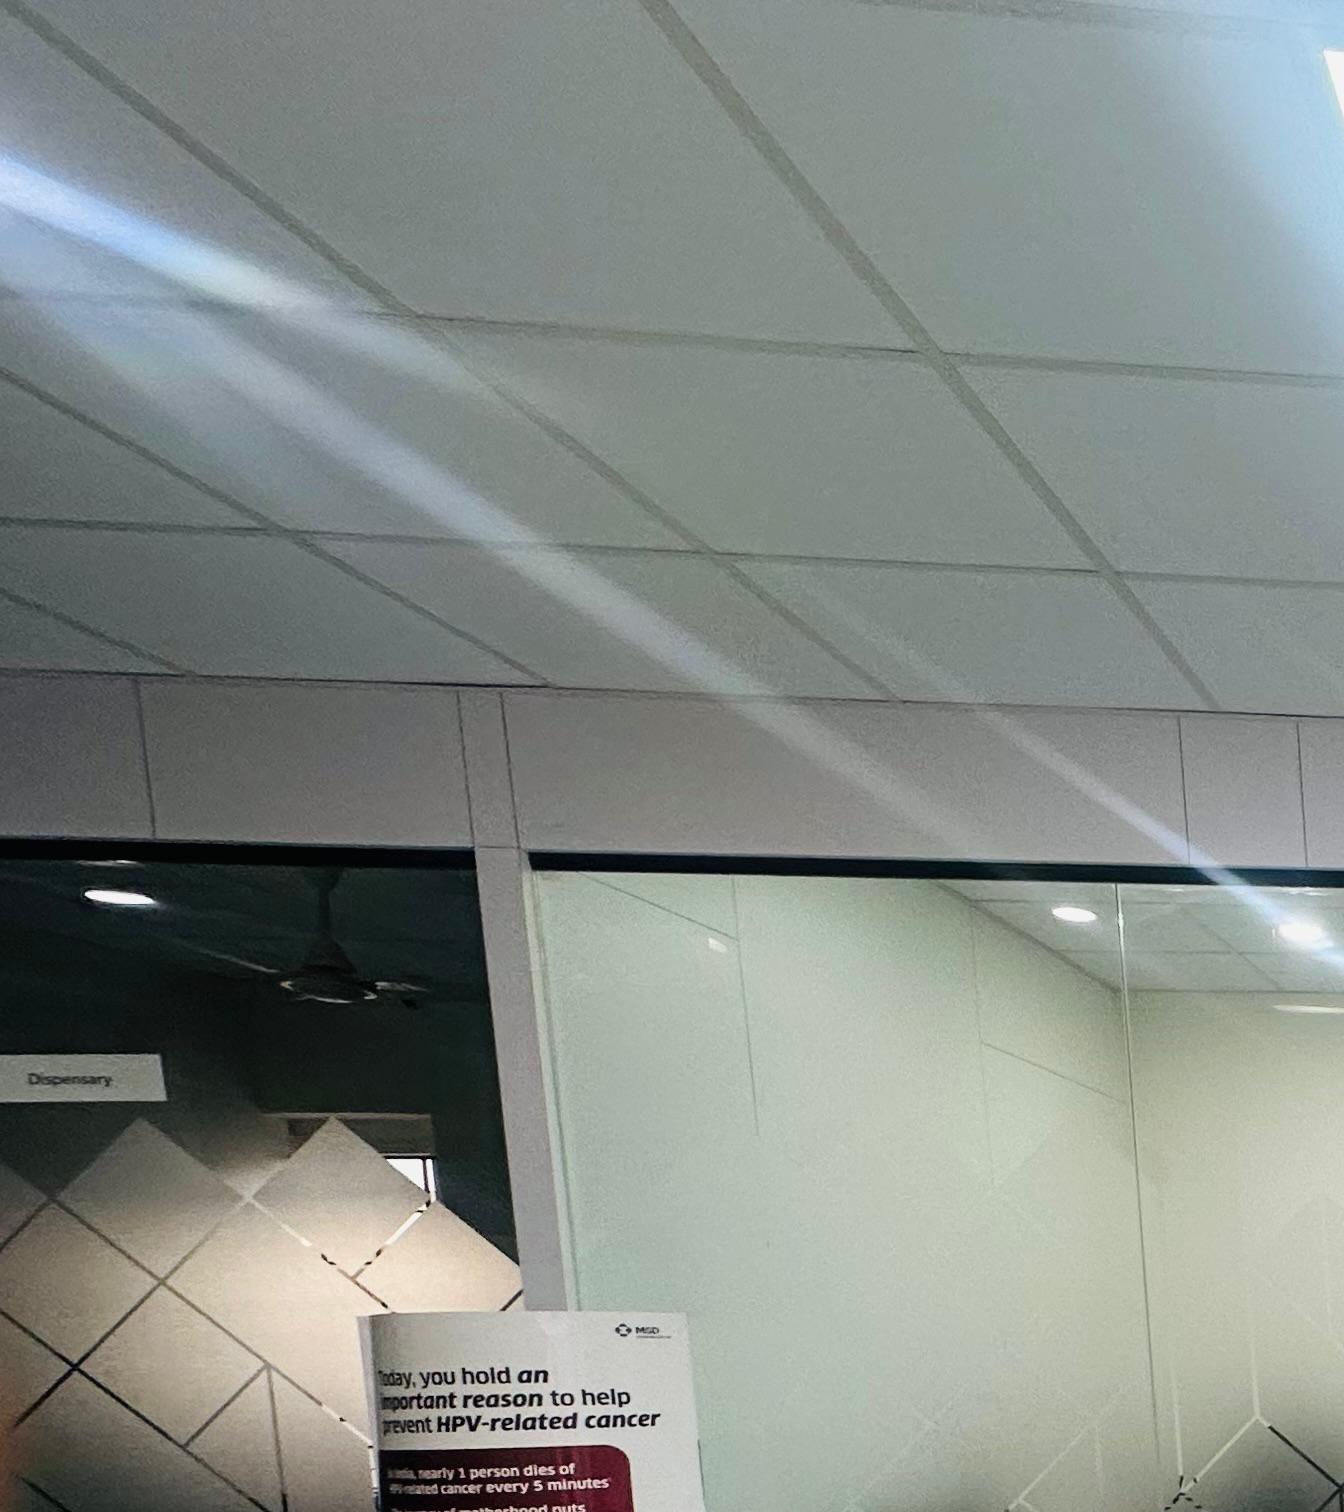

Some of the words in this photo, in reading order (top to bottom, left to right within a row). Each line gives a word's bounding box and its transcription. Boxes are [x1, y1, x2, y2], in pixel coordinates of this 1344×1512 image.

[28, 1072, 112, 1088] Dispensary
[419, 1371, 456, 1389] you
[461, 1367, 511, 1384] hold
[517, 1369, 549, 1384] an
[462, 1392, 543, 1408] reason
[550, 1390, 575, 1407] to
[581, 1388, 631, 1407] help
[437, 1412, 578, 1432] HPV-related
[585, 1413, 661, 1429] cancer
[458, 1467, 466, 1478] 1
[469, 1466, 520, 1480] person
[523, 1464, 556, 1477] dies
[559, 1462, 576, 1475] of
[440, 1484, 482, 1494] cancer
[485, 1482, 529, 1494] every
[533, 1480, 544, 1491] 5
